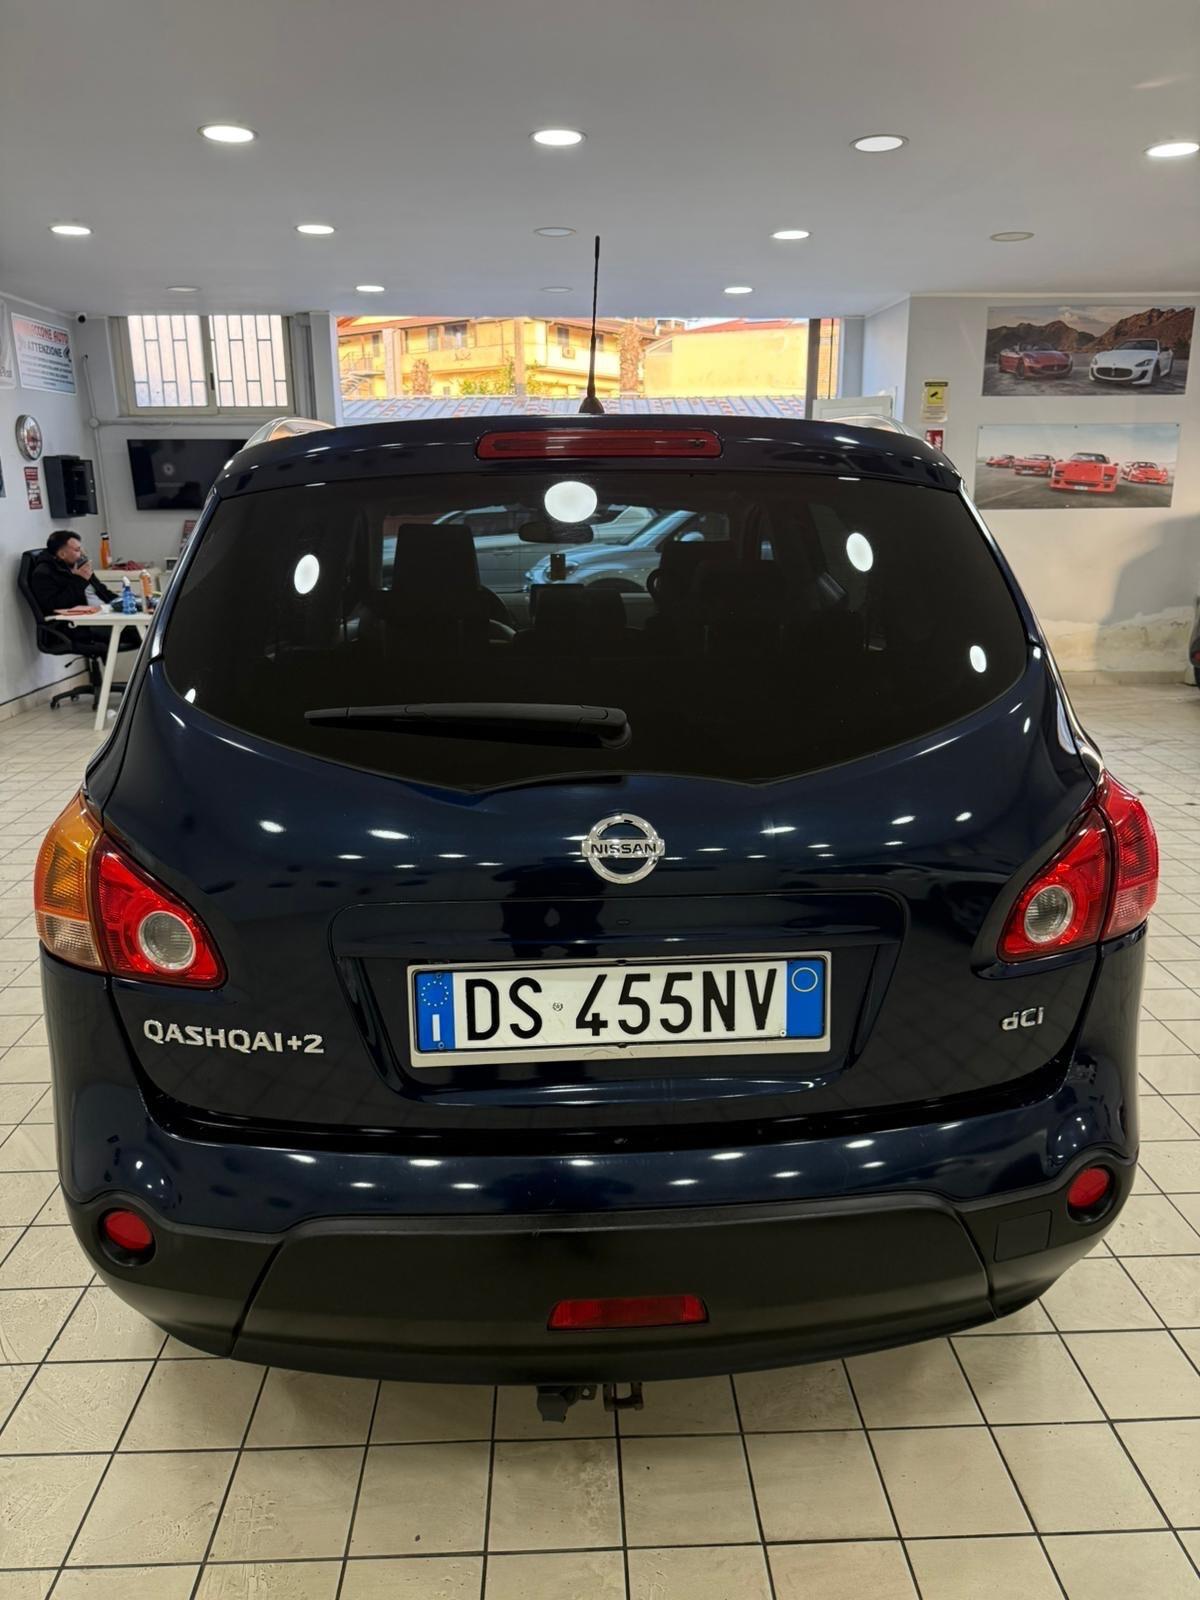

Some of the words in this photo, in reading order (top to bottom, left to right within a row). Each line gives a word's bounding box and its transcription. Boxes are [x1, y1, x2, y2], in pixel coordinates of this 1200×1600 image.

[591, 843, 657, 855] NISSAN
[465, 977, 543, 1041] DS
[576, 968, 777, 1037] 455NV
[143, 1019, 325, 1054] QASHQAI+2
